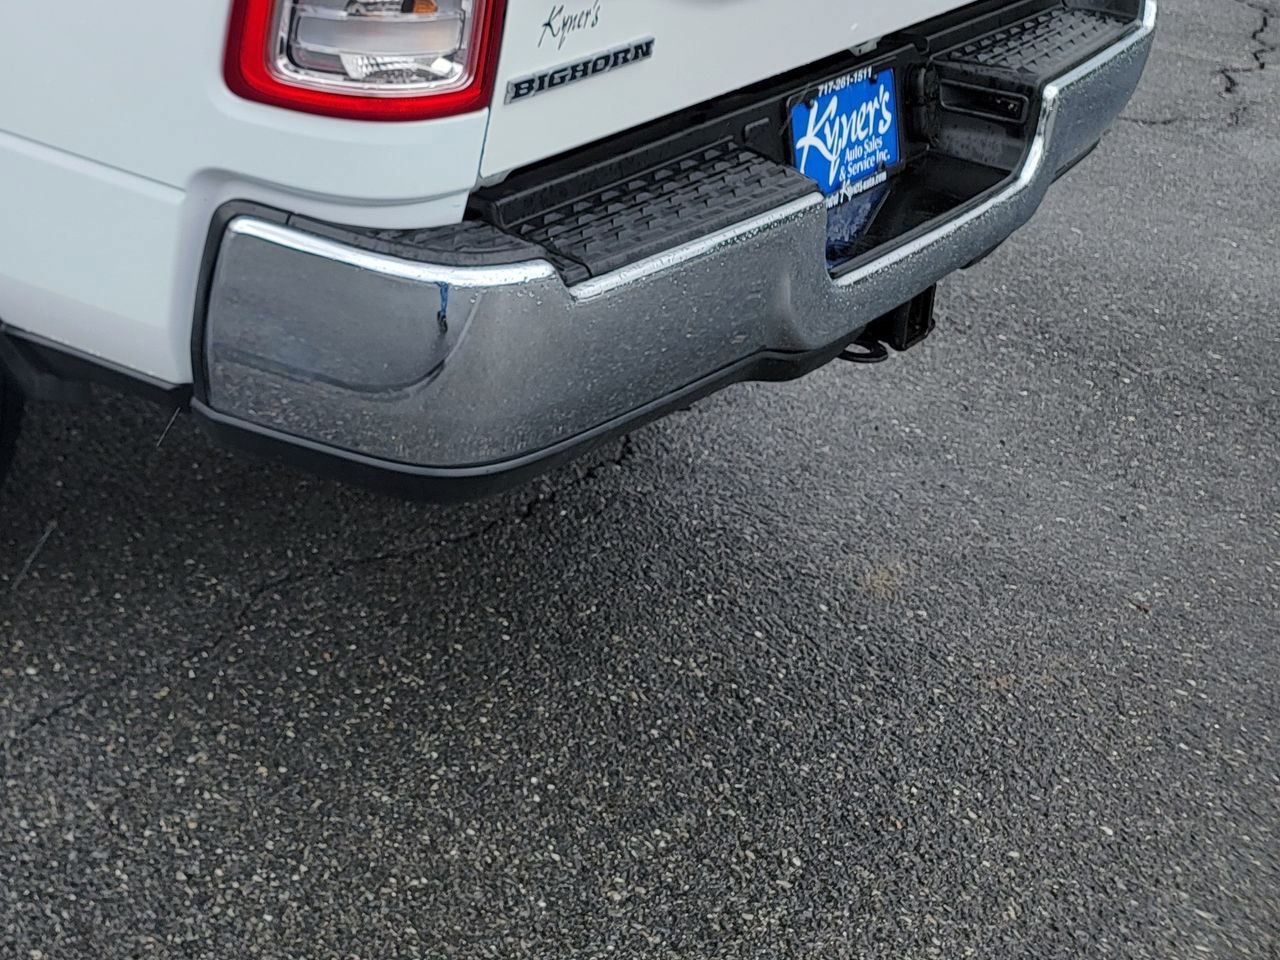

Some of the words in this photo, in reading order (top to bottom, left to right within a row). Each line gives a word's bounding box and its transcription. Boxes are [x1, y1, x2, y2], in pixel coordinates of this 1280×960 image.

[509, 39, 656, 102] BIGHORN
[795, 83, 893, 187] Kyner's
[844, 145, 863, 163] Auto
[863, 135, 883, 157] Sales
[838, 165, 847, 181] &
[847, 154, 876, 178] Service
